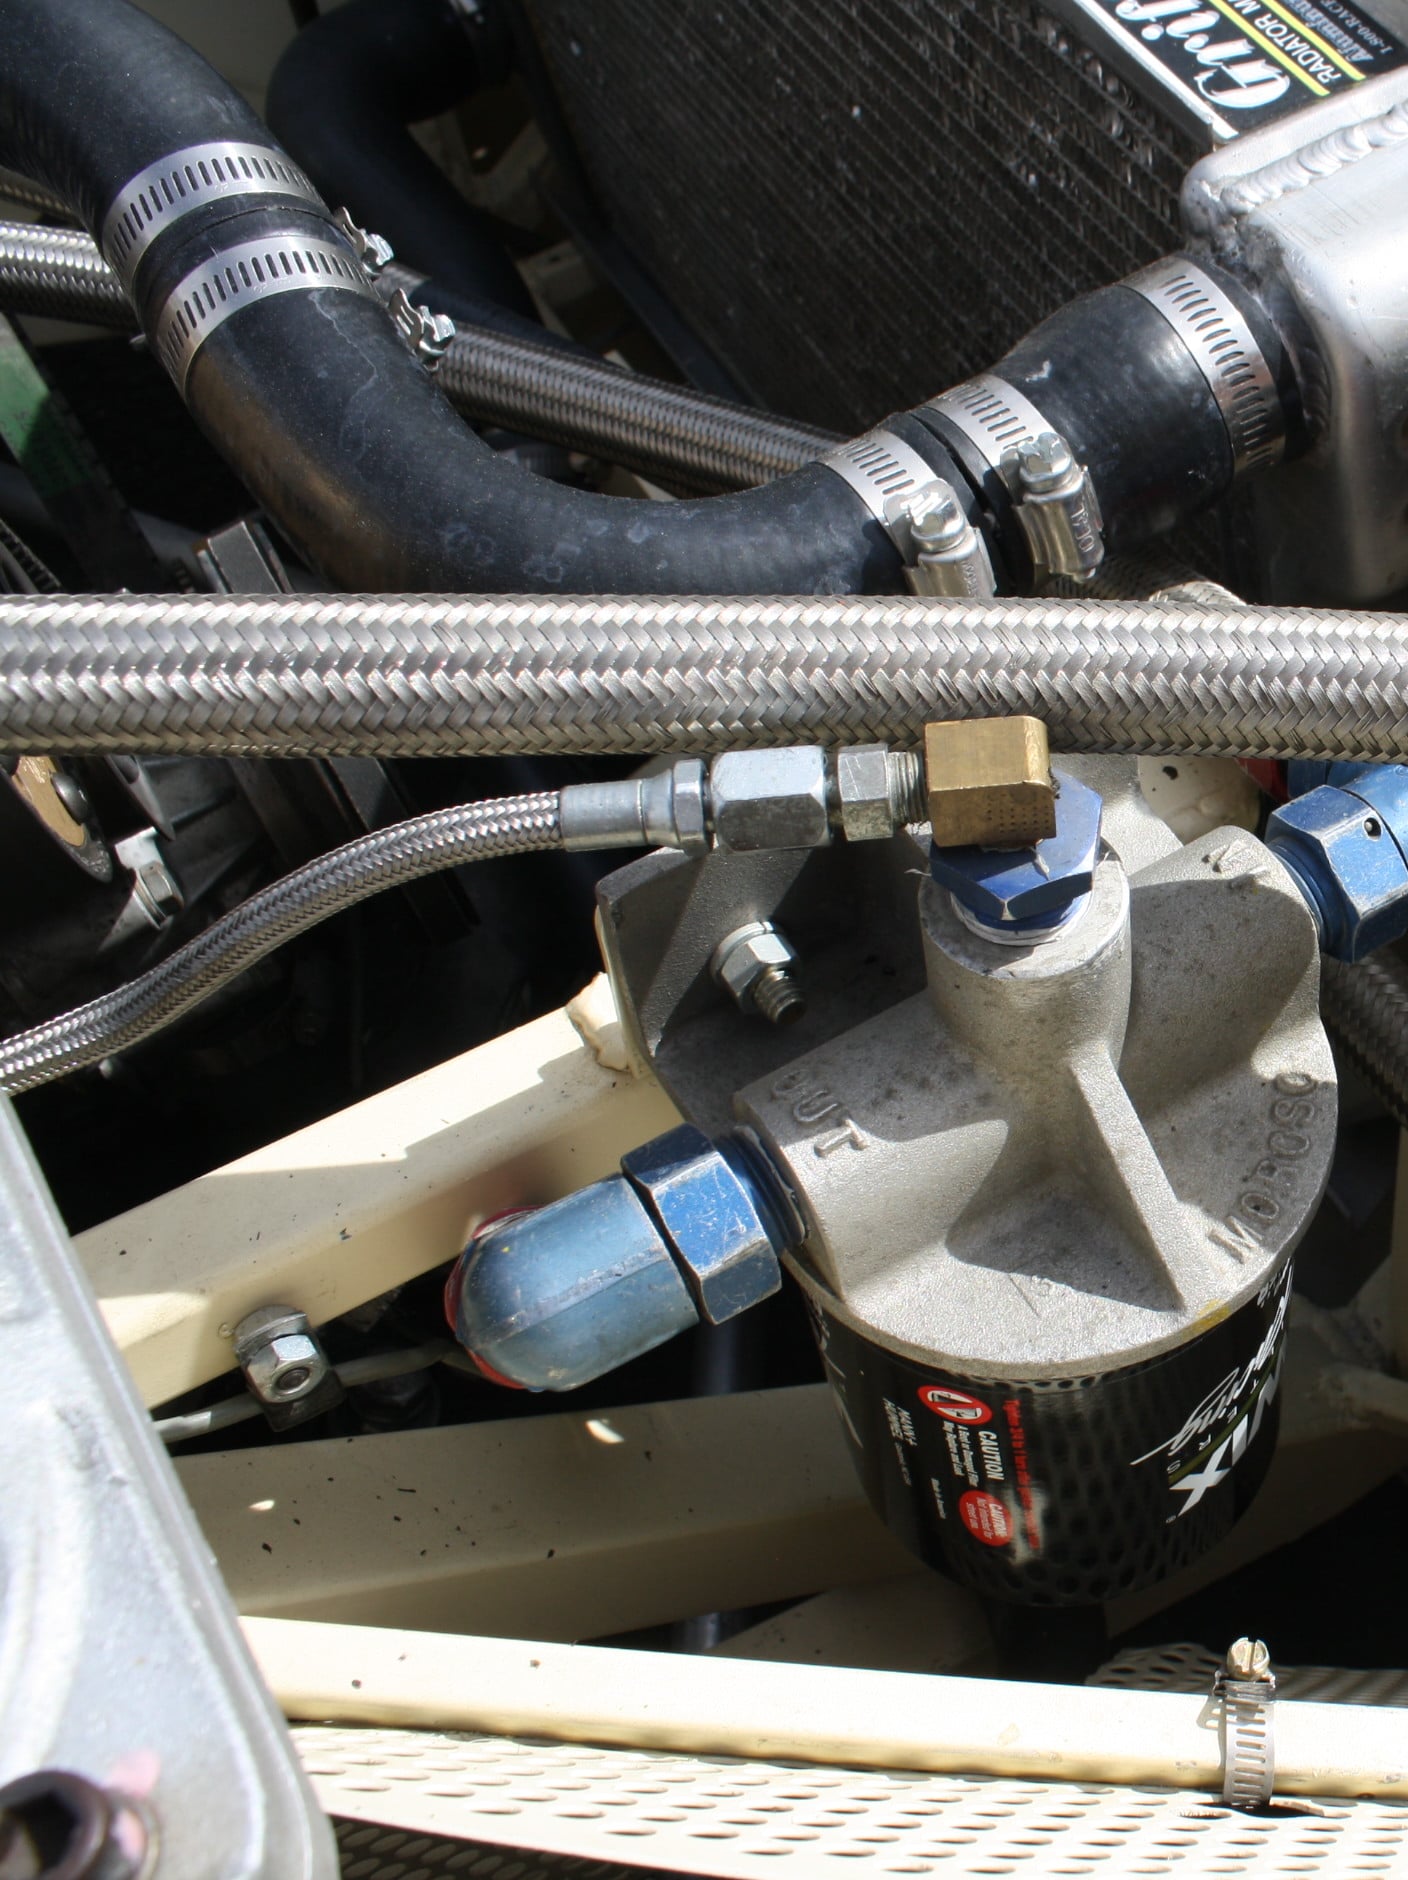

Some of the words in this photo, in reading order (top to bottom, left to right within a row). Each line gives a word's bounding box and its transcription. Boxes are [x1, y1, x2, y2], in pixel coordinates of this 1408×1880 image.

[1228, 0, 1261, 15] M
[1284, 0, 1374, 62] Aluminu
[1254, 13, 1342, 84] RADIATOR
[771, 1071, 871, 1159] OUT
[1207, 1072, 1318, 1265] MOROSO
[978, 1431, 1005, 1479] CAUTION
